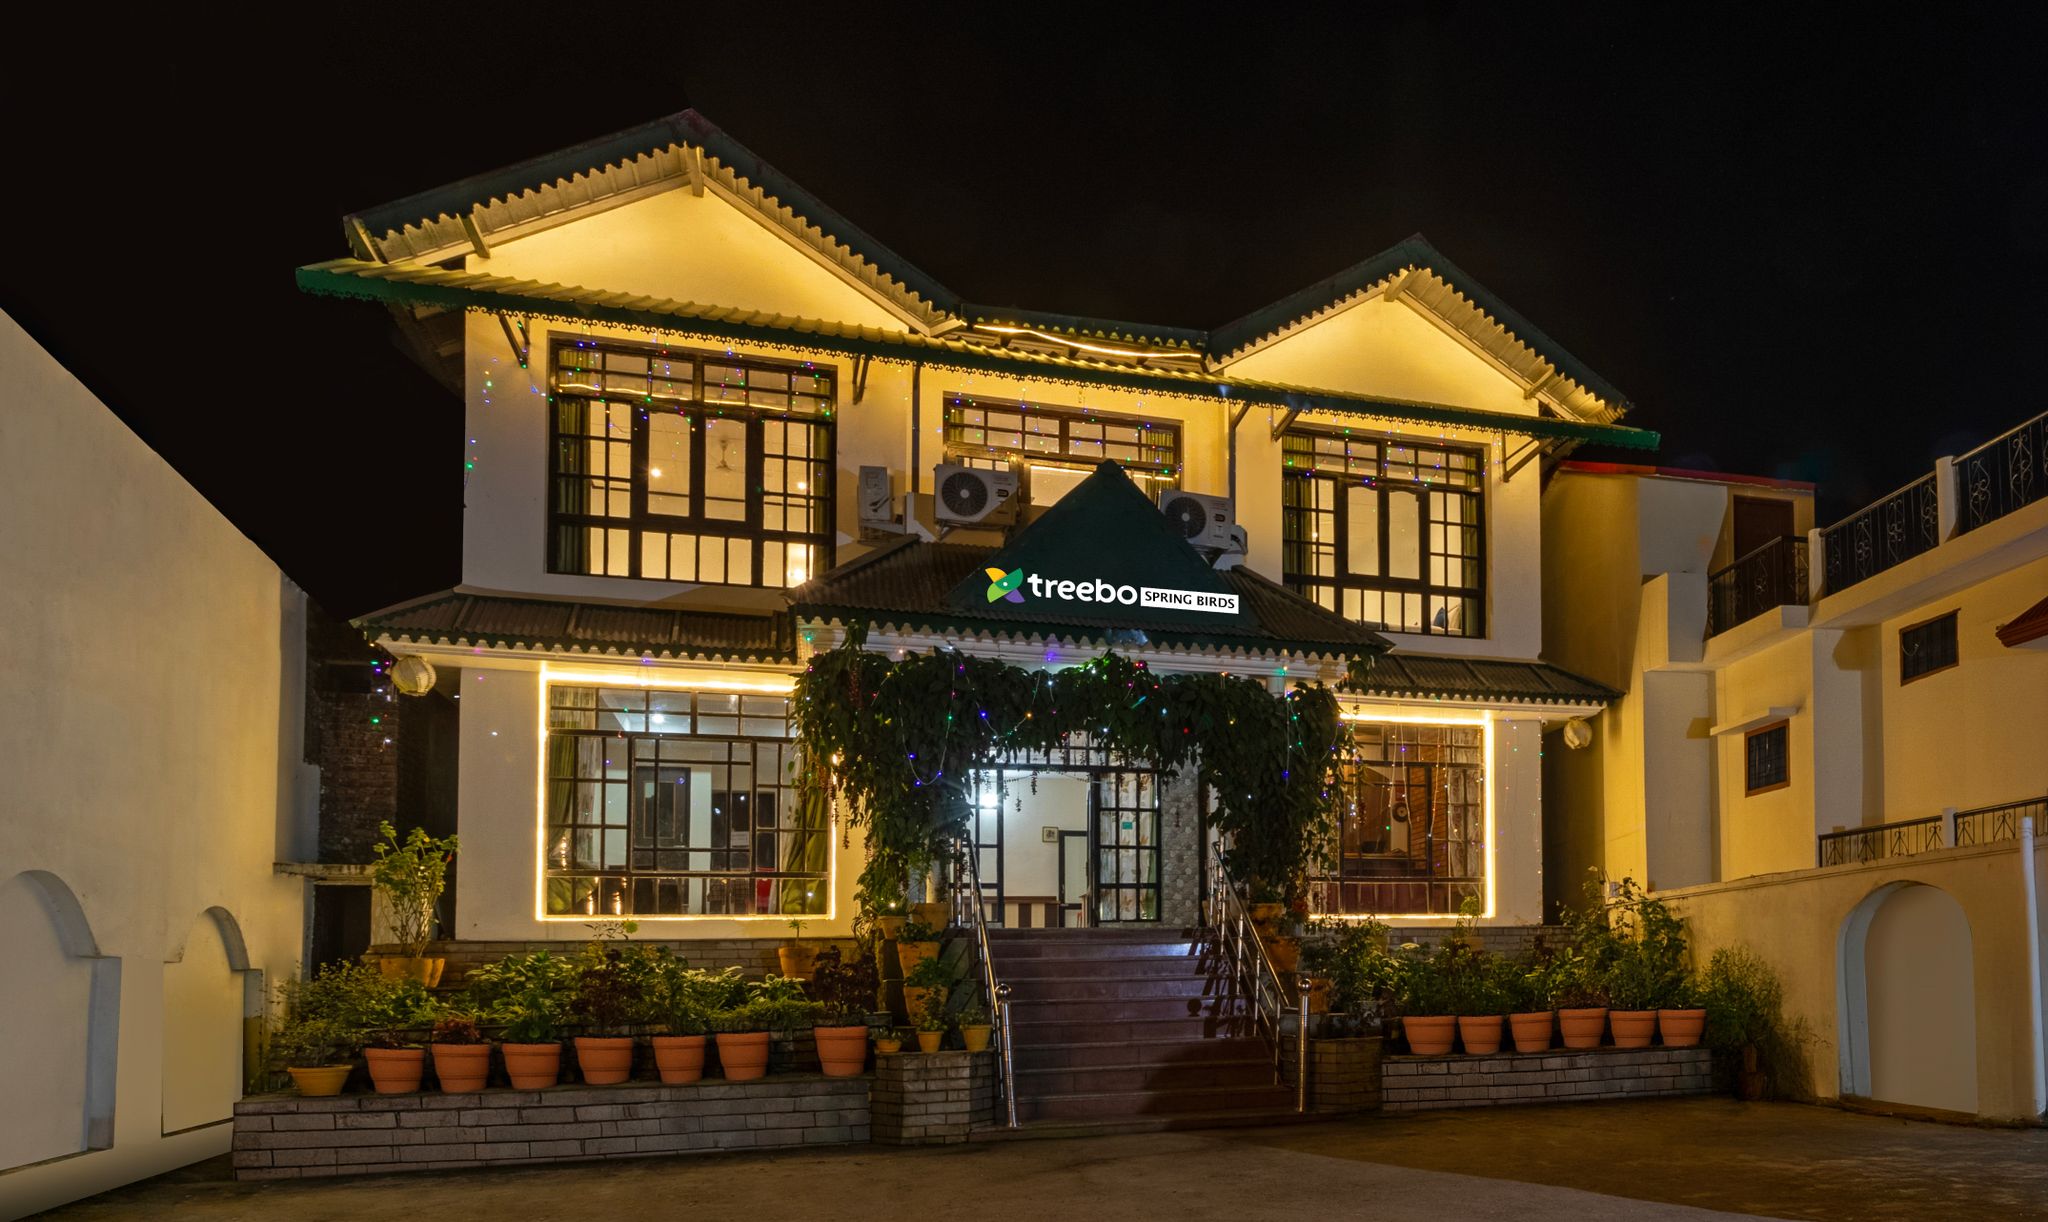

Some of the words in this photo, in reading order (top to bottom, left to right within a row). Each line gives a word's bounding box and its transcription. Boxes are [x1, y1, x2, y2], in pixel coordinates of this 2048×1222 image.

[1027, 574, 1138, 605] treebo
[1144, 590, 1192, 605] SPRING
[1196, 596, 1235, 609] BIRDS
